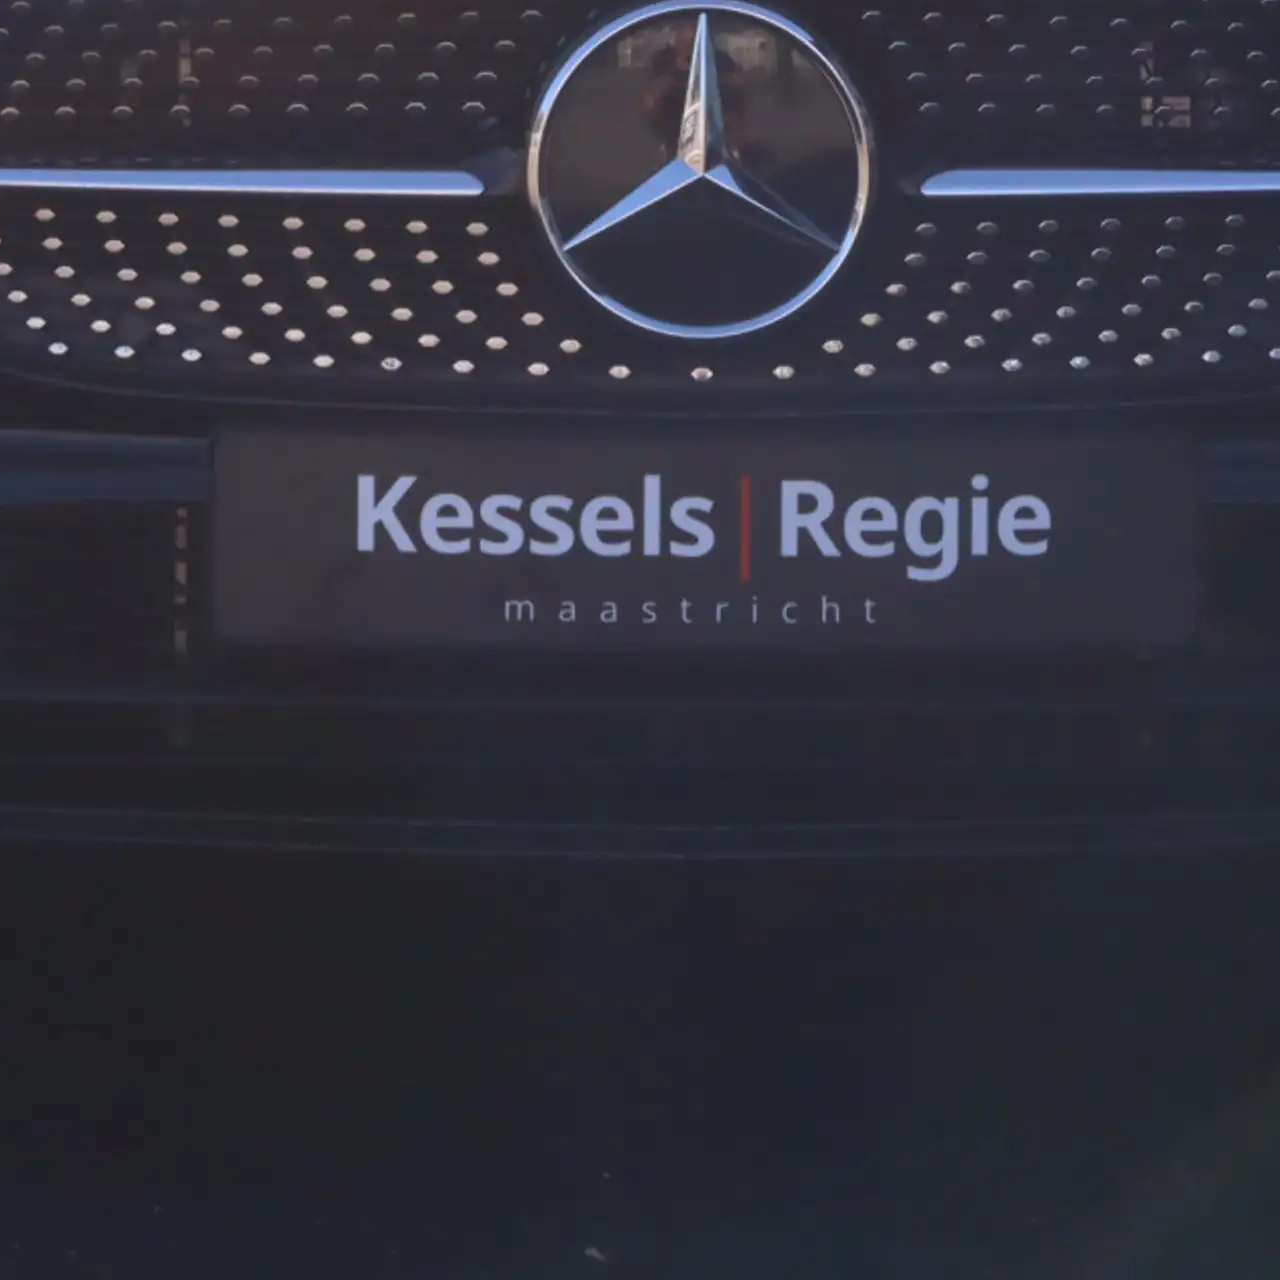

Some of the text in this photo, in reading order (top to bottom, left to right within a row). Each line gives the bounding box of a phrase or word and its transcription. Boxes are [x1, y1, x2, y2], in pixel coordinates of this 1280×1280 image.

[356, 473, 1052, 582] Kessels Regie
[503, 593, 878, 625] maastricht
